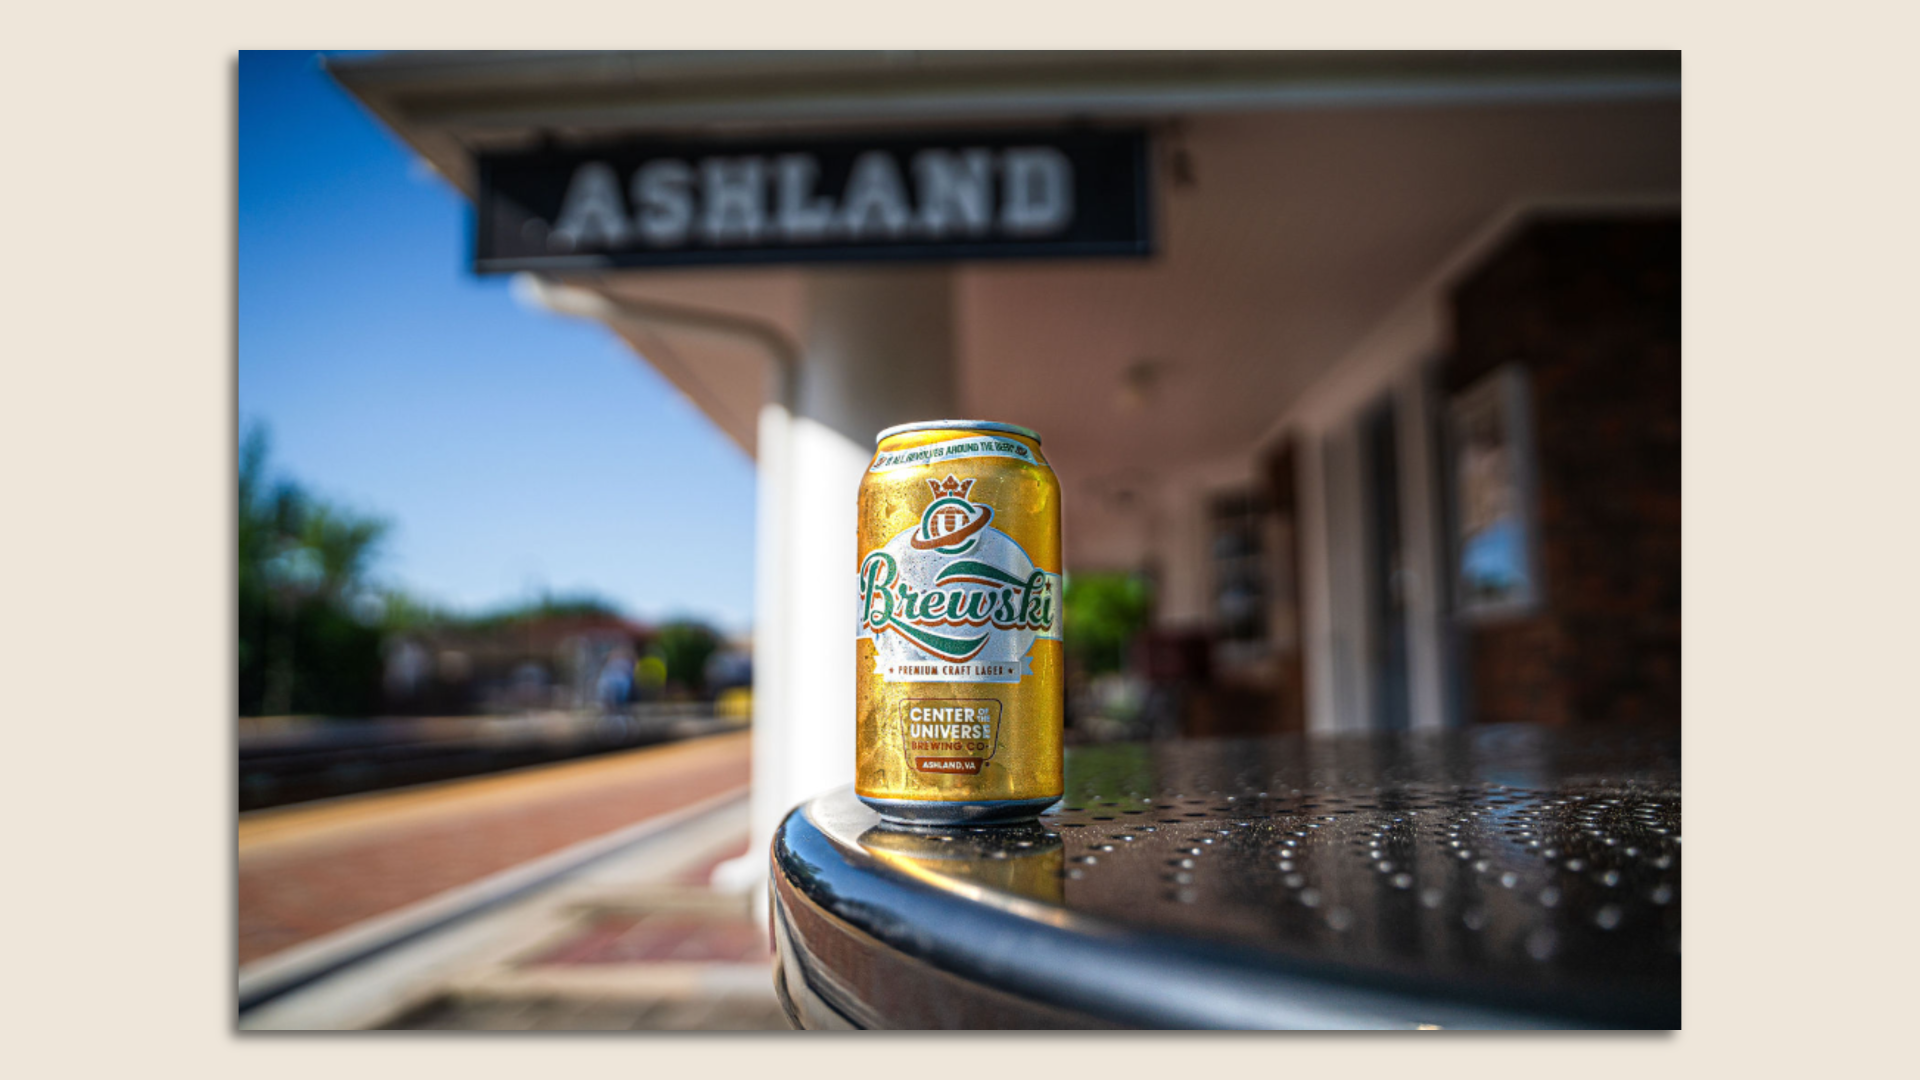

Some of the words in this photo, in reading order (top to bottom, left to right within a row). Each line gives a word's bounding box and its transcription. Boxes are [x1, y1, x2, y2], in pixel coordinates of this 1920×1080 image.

[554, 147, 1075, 247] ASHLAND
[945, 442, 979, 455] AROUND
[980, 441, 994, 452] THE
[995, 441, 1015, 453] BEER
[859, 551, 1054, 632] Brewski
[898, 665, 938, 675] PREMIUM
[942, 665, 971, 675] CRAFT
[975, 665, 1003, 675] LAGER
[909, 707, 975, 722] CENTER
[910, 724, 991, 739] UNIVERSE
[911, 742, 963, 751] BREWING
